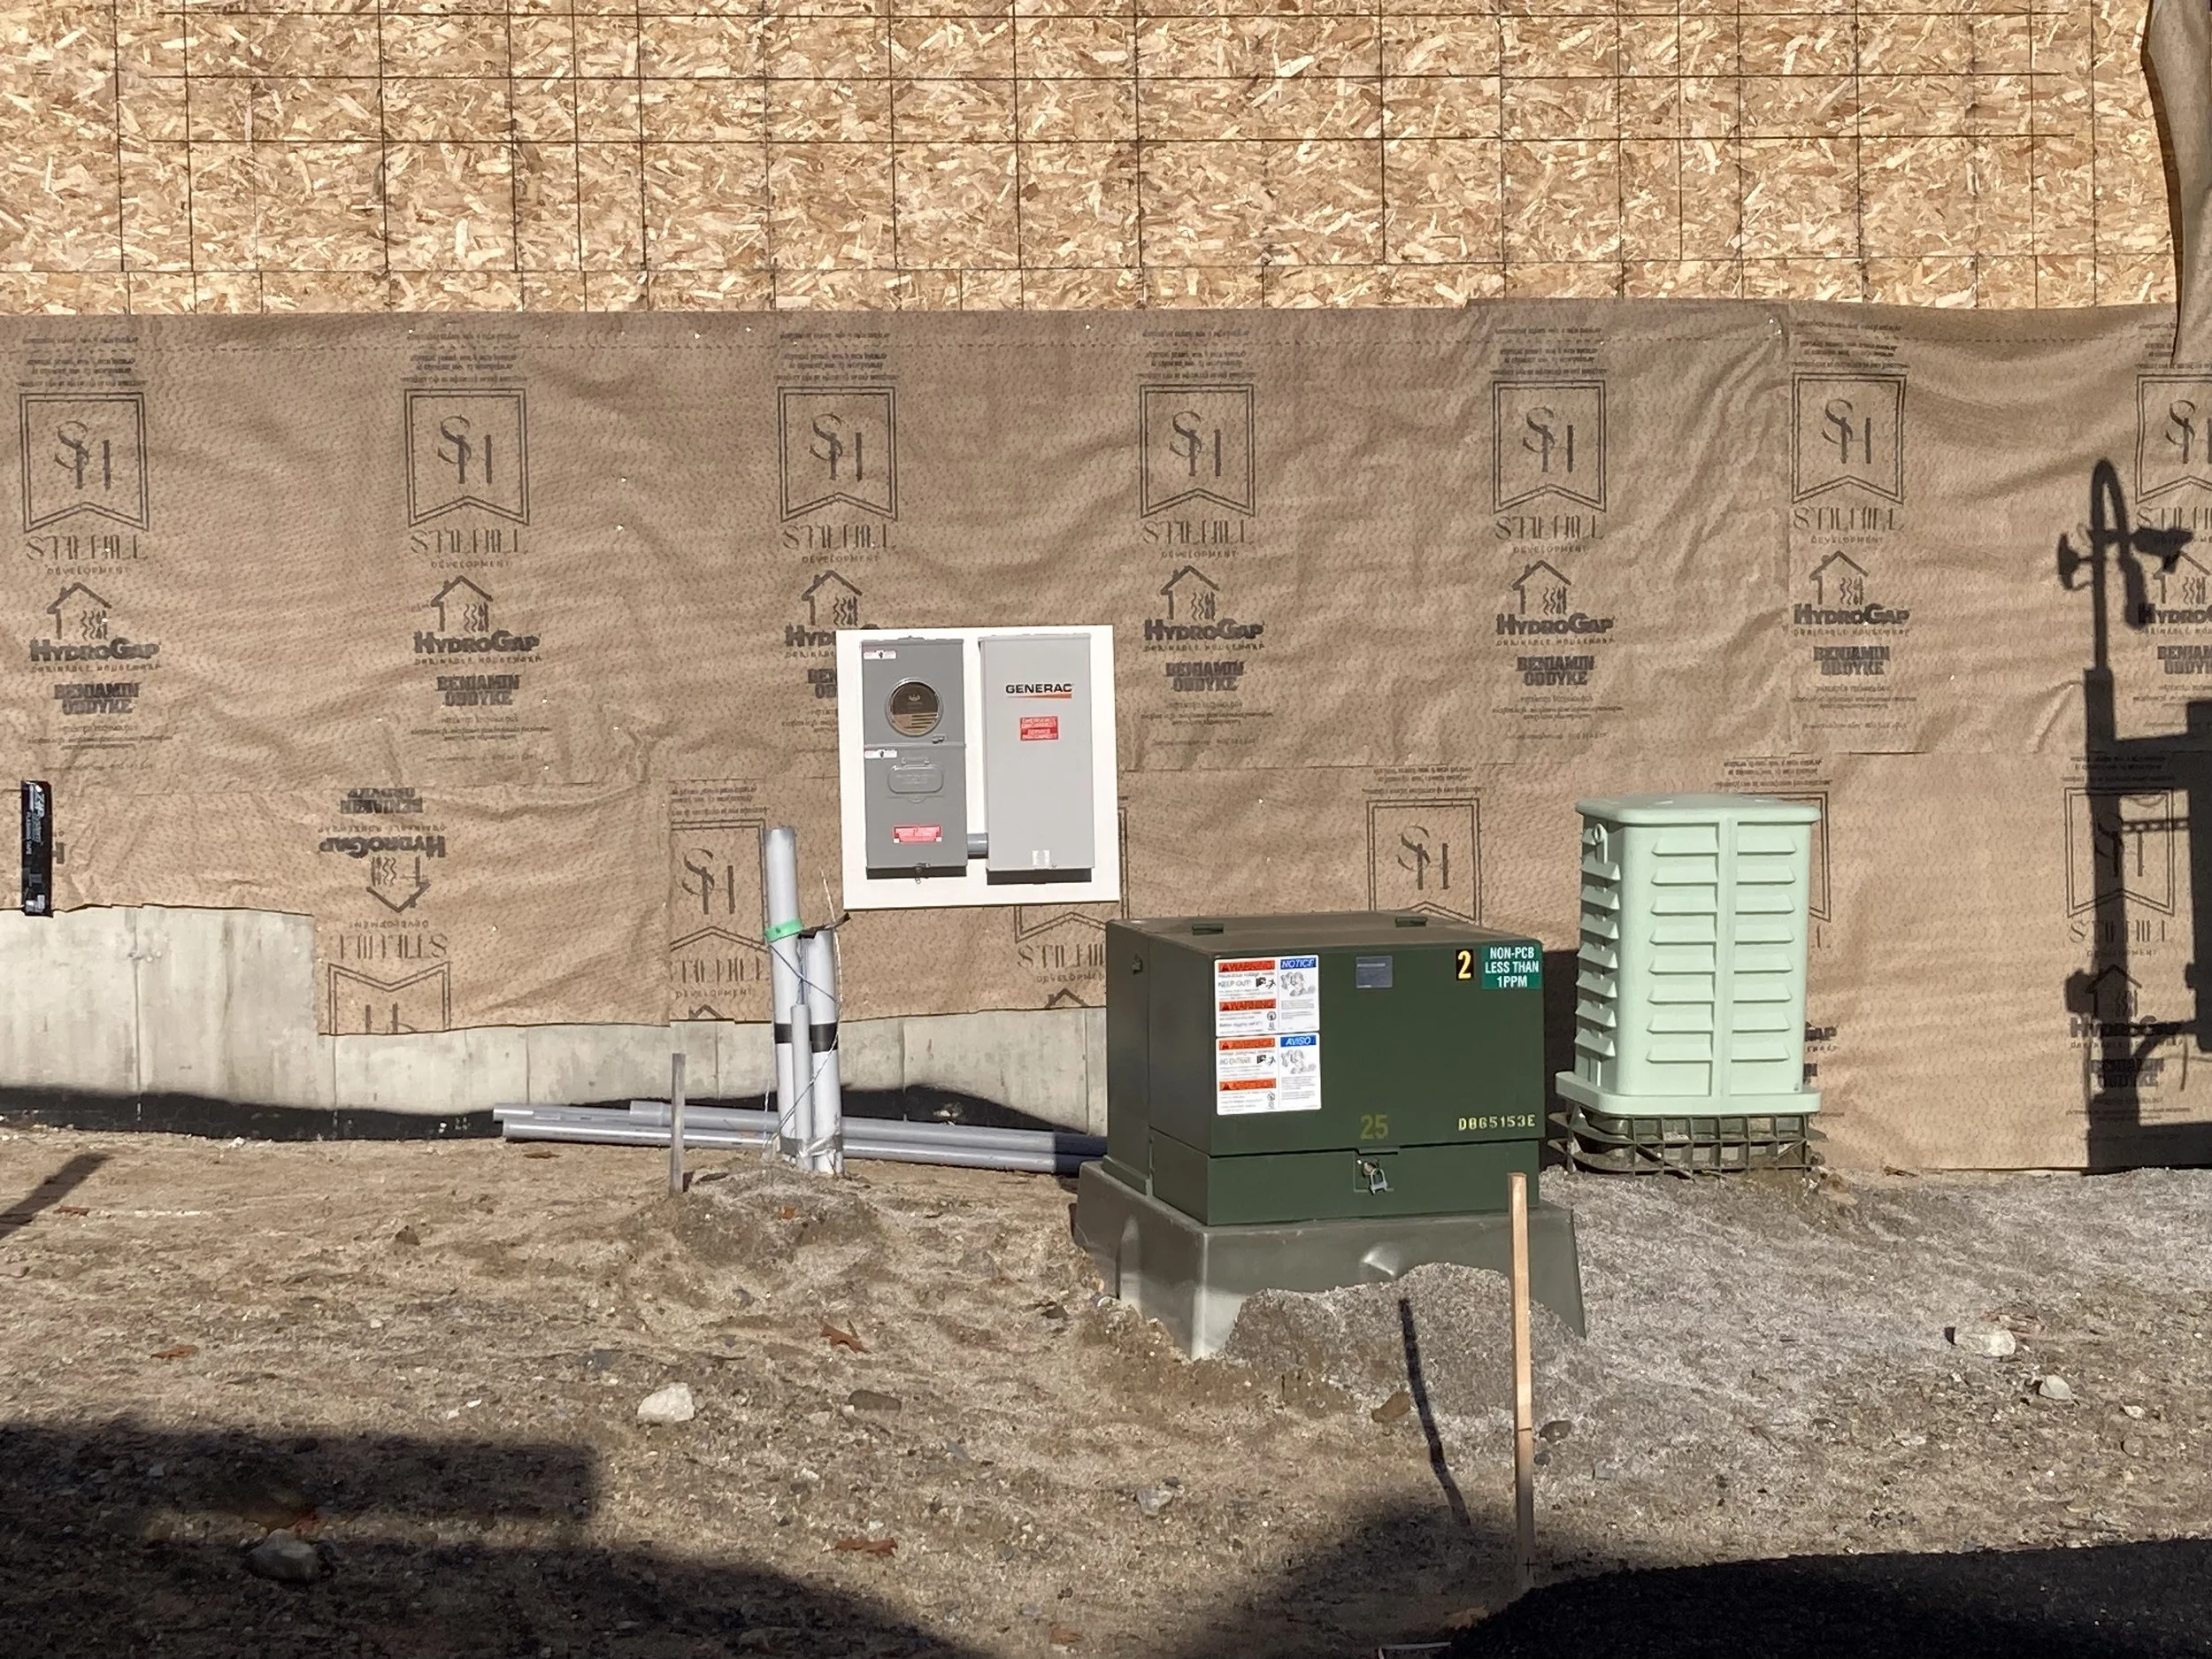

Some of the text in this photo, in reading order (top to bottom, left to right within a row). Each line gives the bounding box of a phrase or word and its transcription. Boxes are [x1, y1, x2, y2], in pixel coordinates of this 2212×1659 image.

[1005, 684, 1072, 694] GENERAC
[1489, 947, 1534, 959] NON-PCB
[1281, 958, 1315, 969] NOTICE
[1457, 950, 1471, 979] 2
[1485, 960, 1539, 973] LESS THAN
[1496, 976, 1527, 987] 1PPM
[1286, 1036, 1311, 1046] AVISO
[1360, 1114, 1388, 1140] 25
